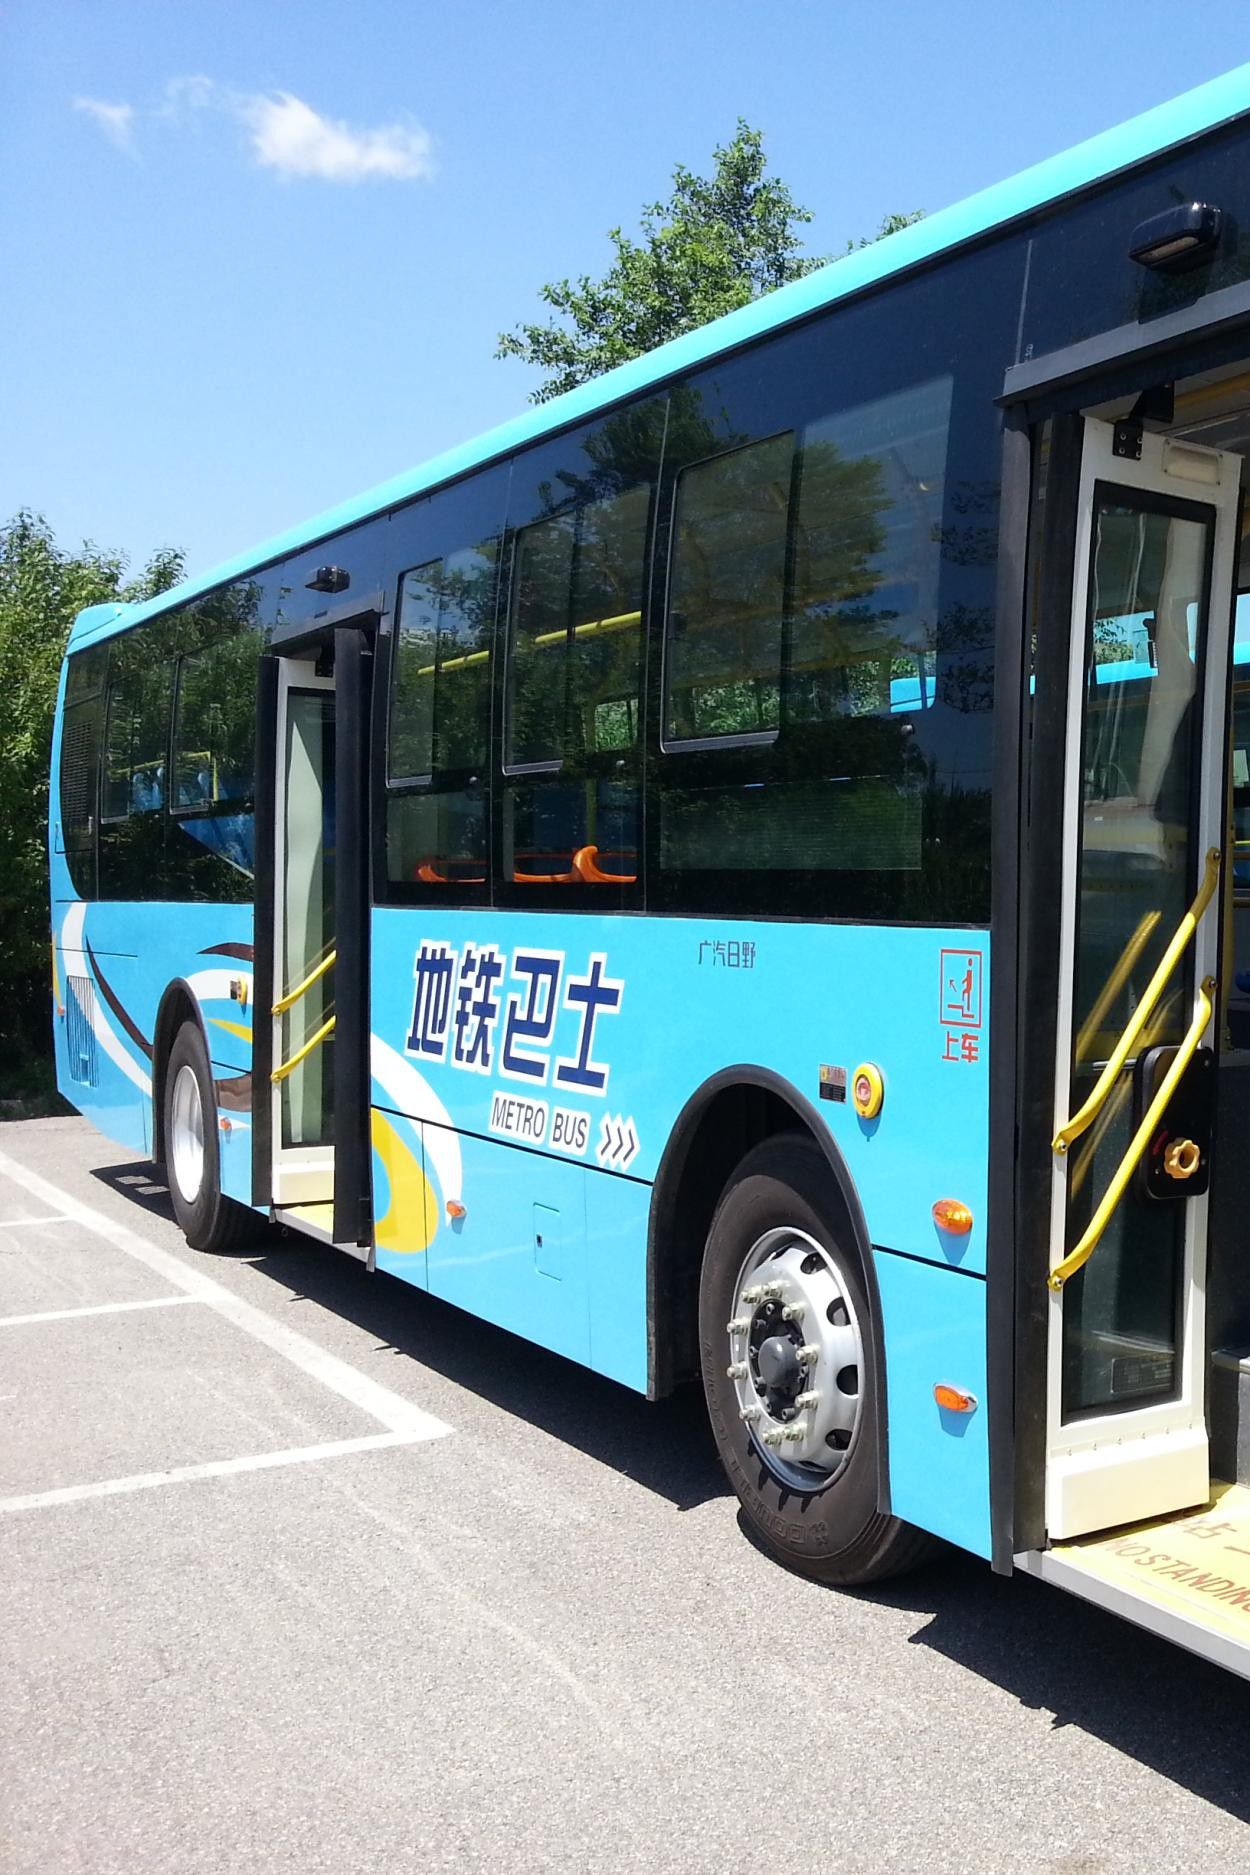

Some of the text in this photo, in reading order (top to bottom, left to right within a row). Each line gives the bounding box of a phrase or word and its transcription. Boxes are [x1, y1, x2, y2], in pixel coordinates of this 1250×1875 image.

[698, 940, 756, 969] 广汽日野
[407, 945, 620, 1089] 地铁巴士
[942, 1031, 979, 1063] 上车
[491, 1096, 588, 1149] METRO BUS
